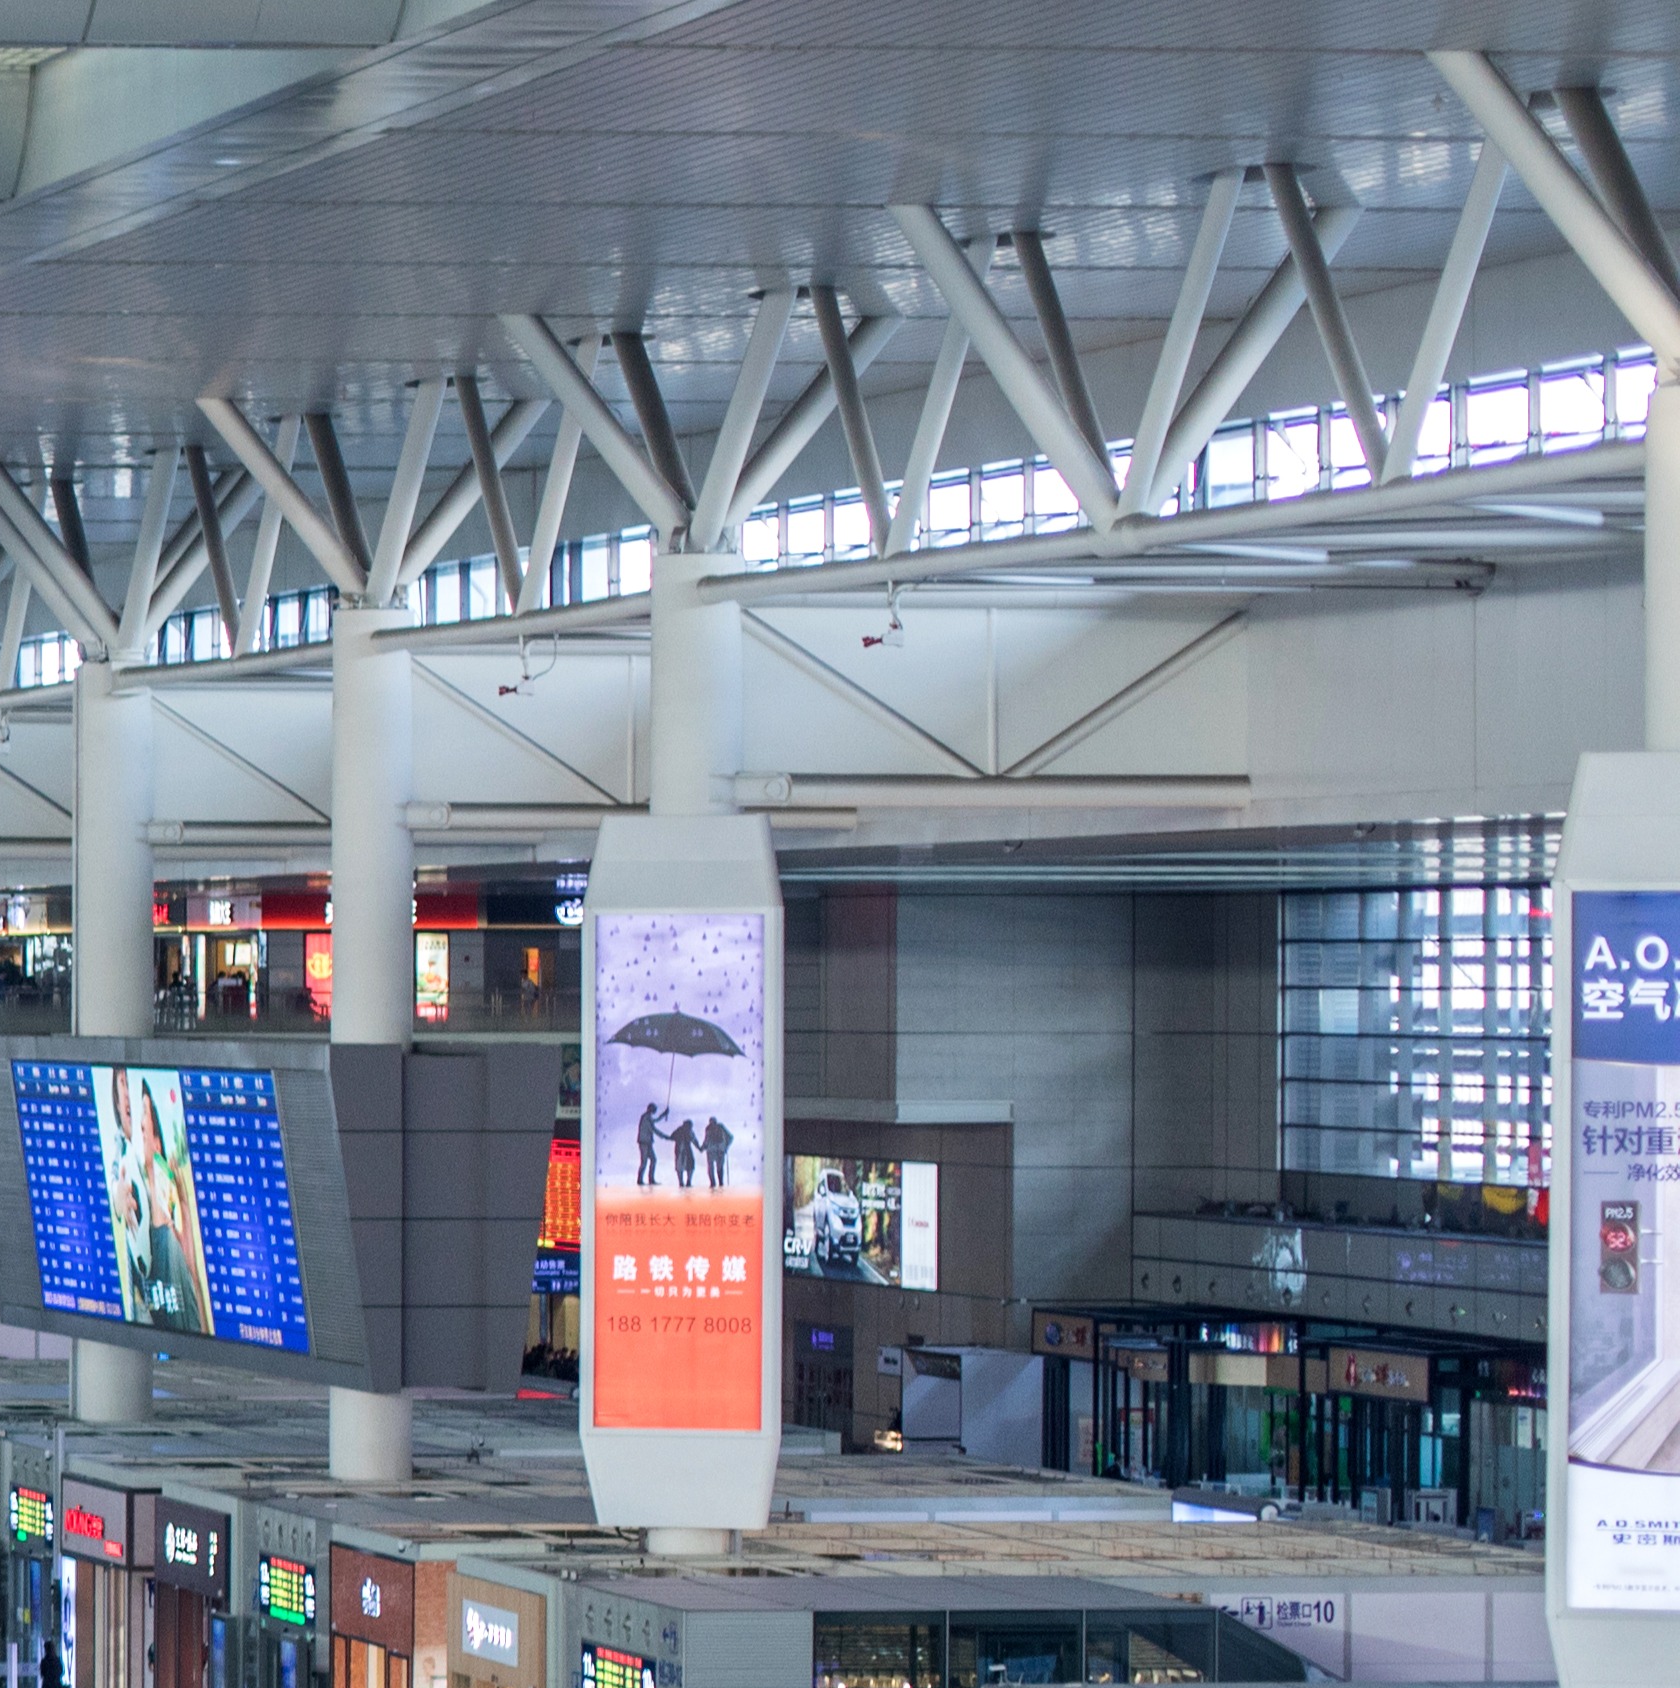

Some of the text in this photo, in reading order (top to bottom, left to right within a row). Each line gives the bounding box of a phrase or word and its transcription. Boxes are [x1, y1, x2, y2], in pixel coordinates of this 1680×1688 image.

[605, 1213, 755, 1228] 你陪我长大 我陪你变老
[613, 1255, 747, 1282] 路铁传媒
[608, 1316, 753, 1335] 188 1777 8008
[1276, 1601, 1335, 1624] 检票口 10
